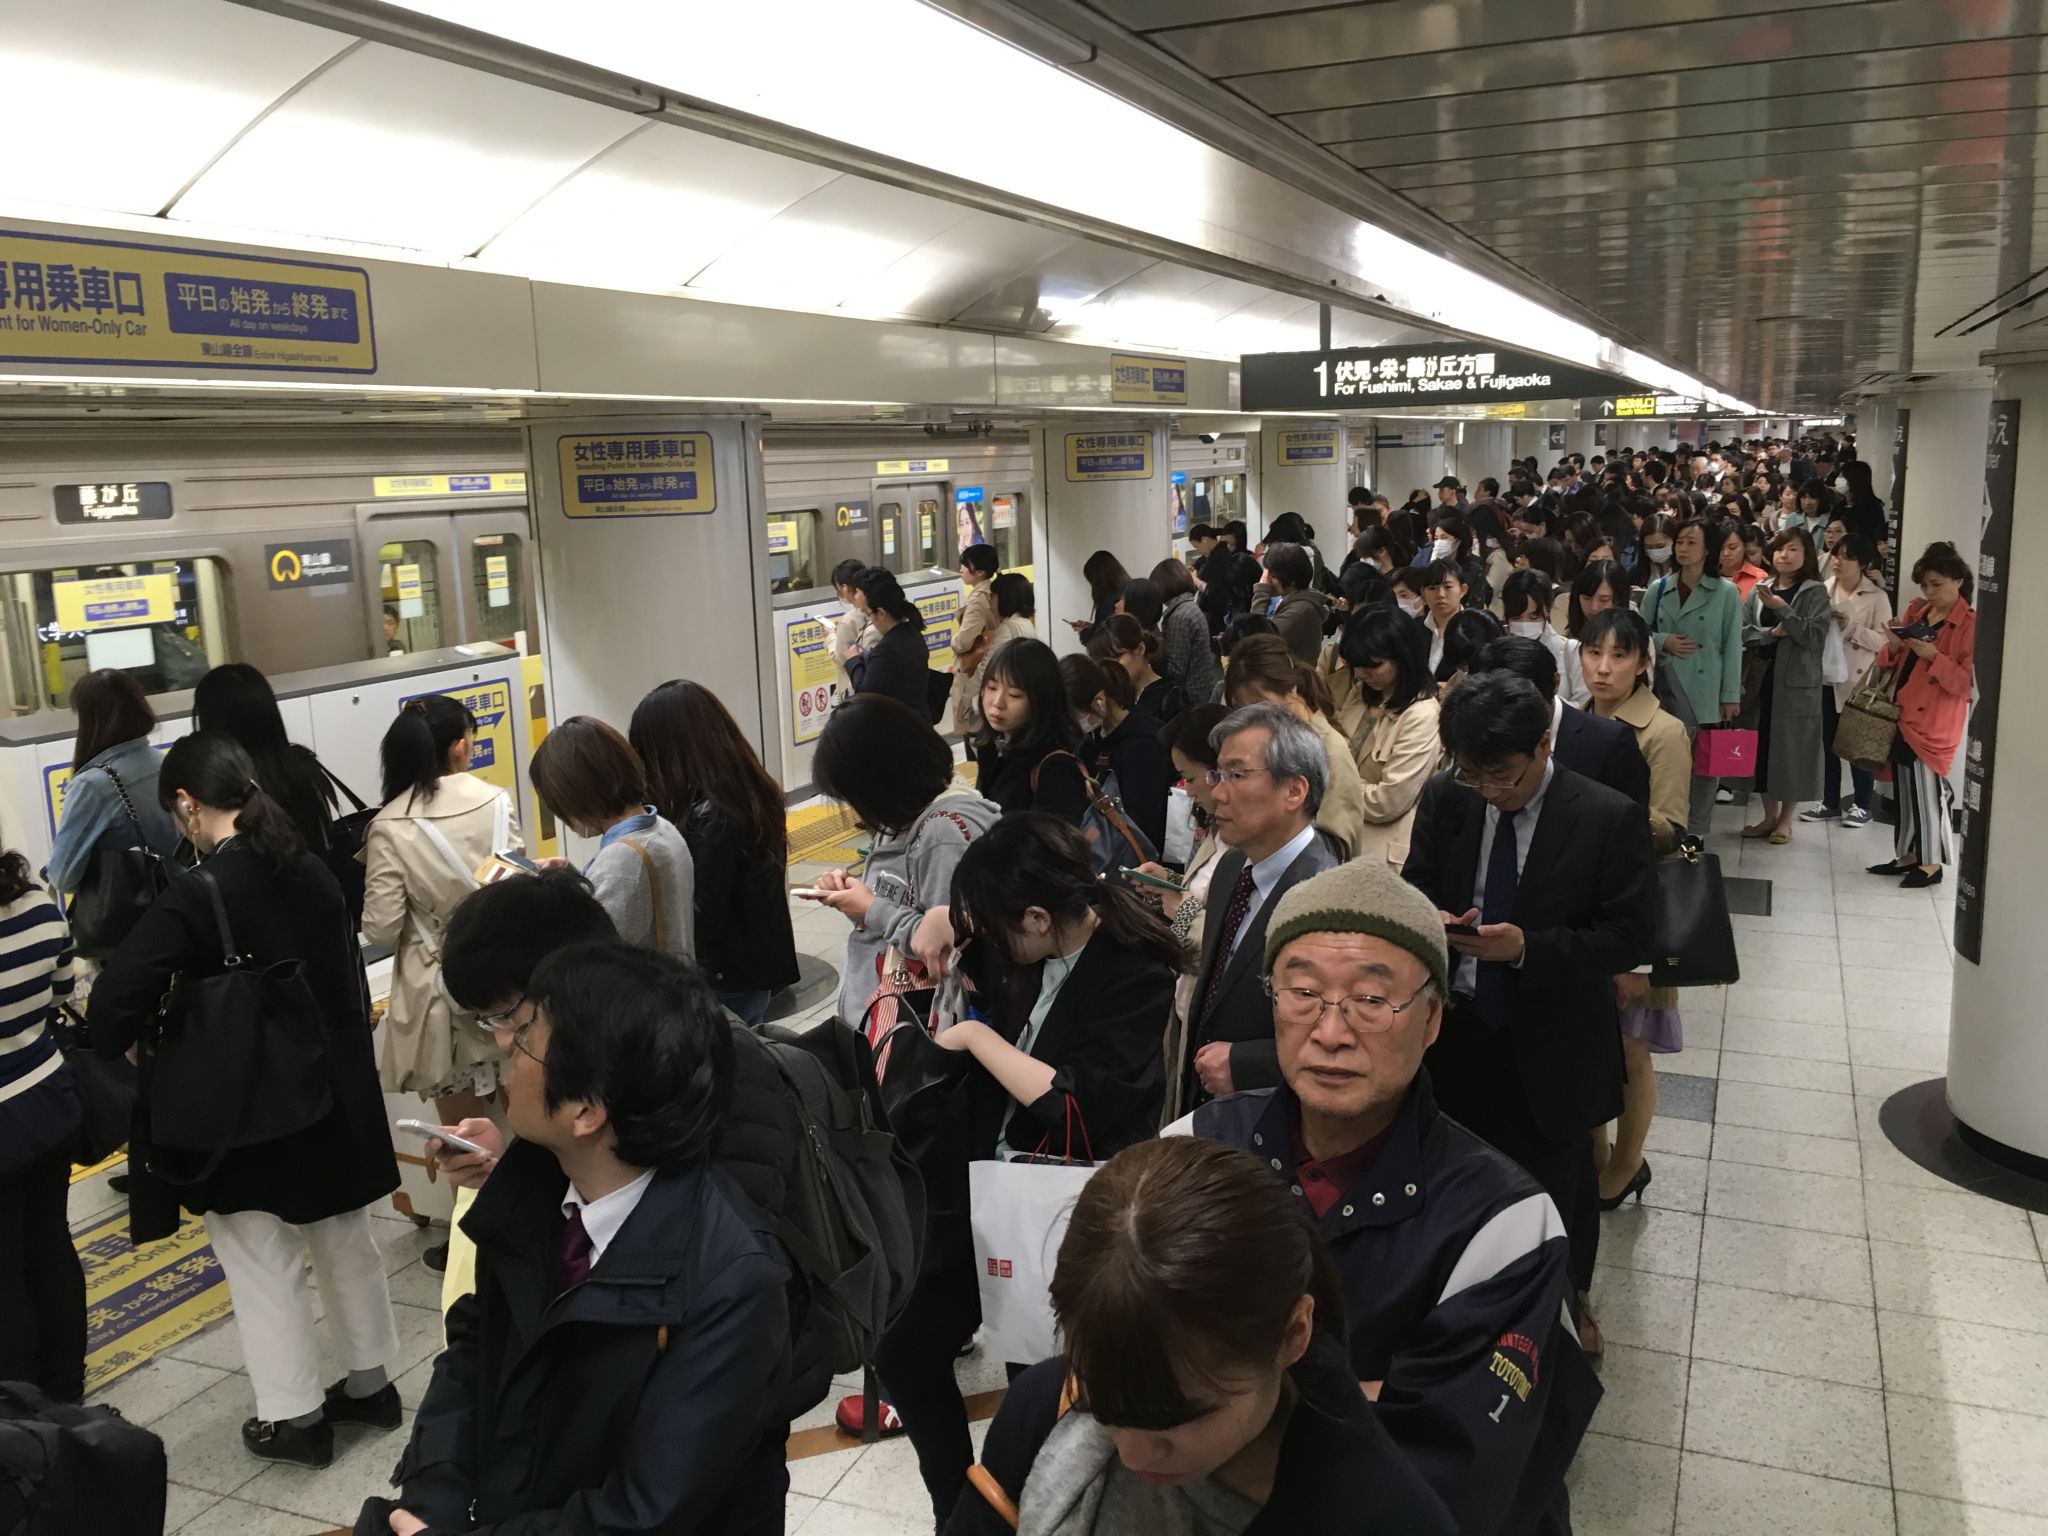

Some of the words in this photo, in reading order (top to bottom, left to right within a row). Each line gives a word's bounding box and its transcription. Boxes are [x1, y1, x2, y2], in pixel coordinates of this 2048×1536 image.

[177, 282, 348, 320] 平日の始発から終発まで
[16, 314, 35, 331] for
[38, 316, 122, 338] Women-Only
[125, 320, 147, 336] Car
[1313, 360, 1328, 397] 1
[1334, 382, 1356, 395] For
[1359, 379, 1415, 394] Fushimi,
[1418, 377, 1463, 391] Sakae
[1465, 376, 1477, 389] &
[1480, 373, 1551, 390] Fujigaoka
[574, 439, 696, 462] 女性専用乗車口
[875, 875, 900, 902] WHERE
[86, 1241, 182, 1290] omen-Only
[138, 1323, 193, 1353] Entire
[191, 1298, 233, 1322] Higa
[1488, 1394, 1510, 1424] 1
